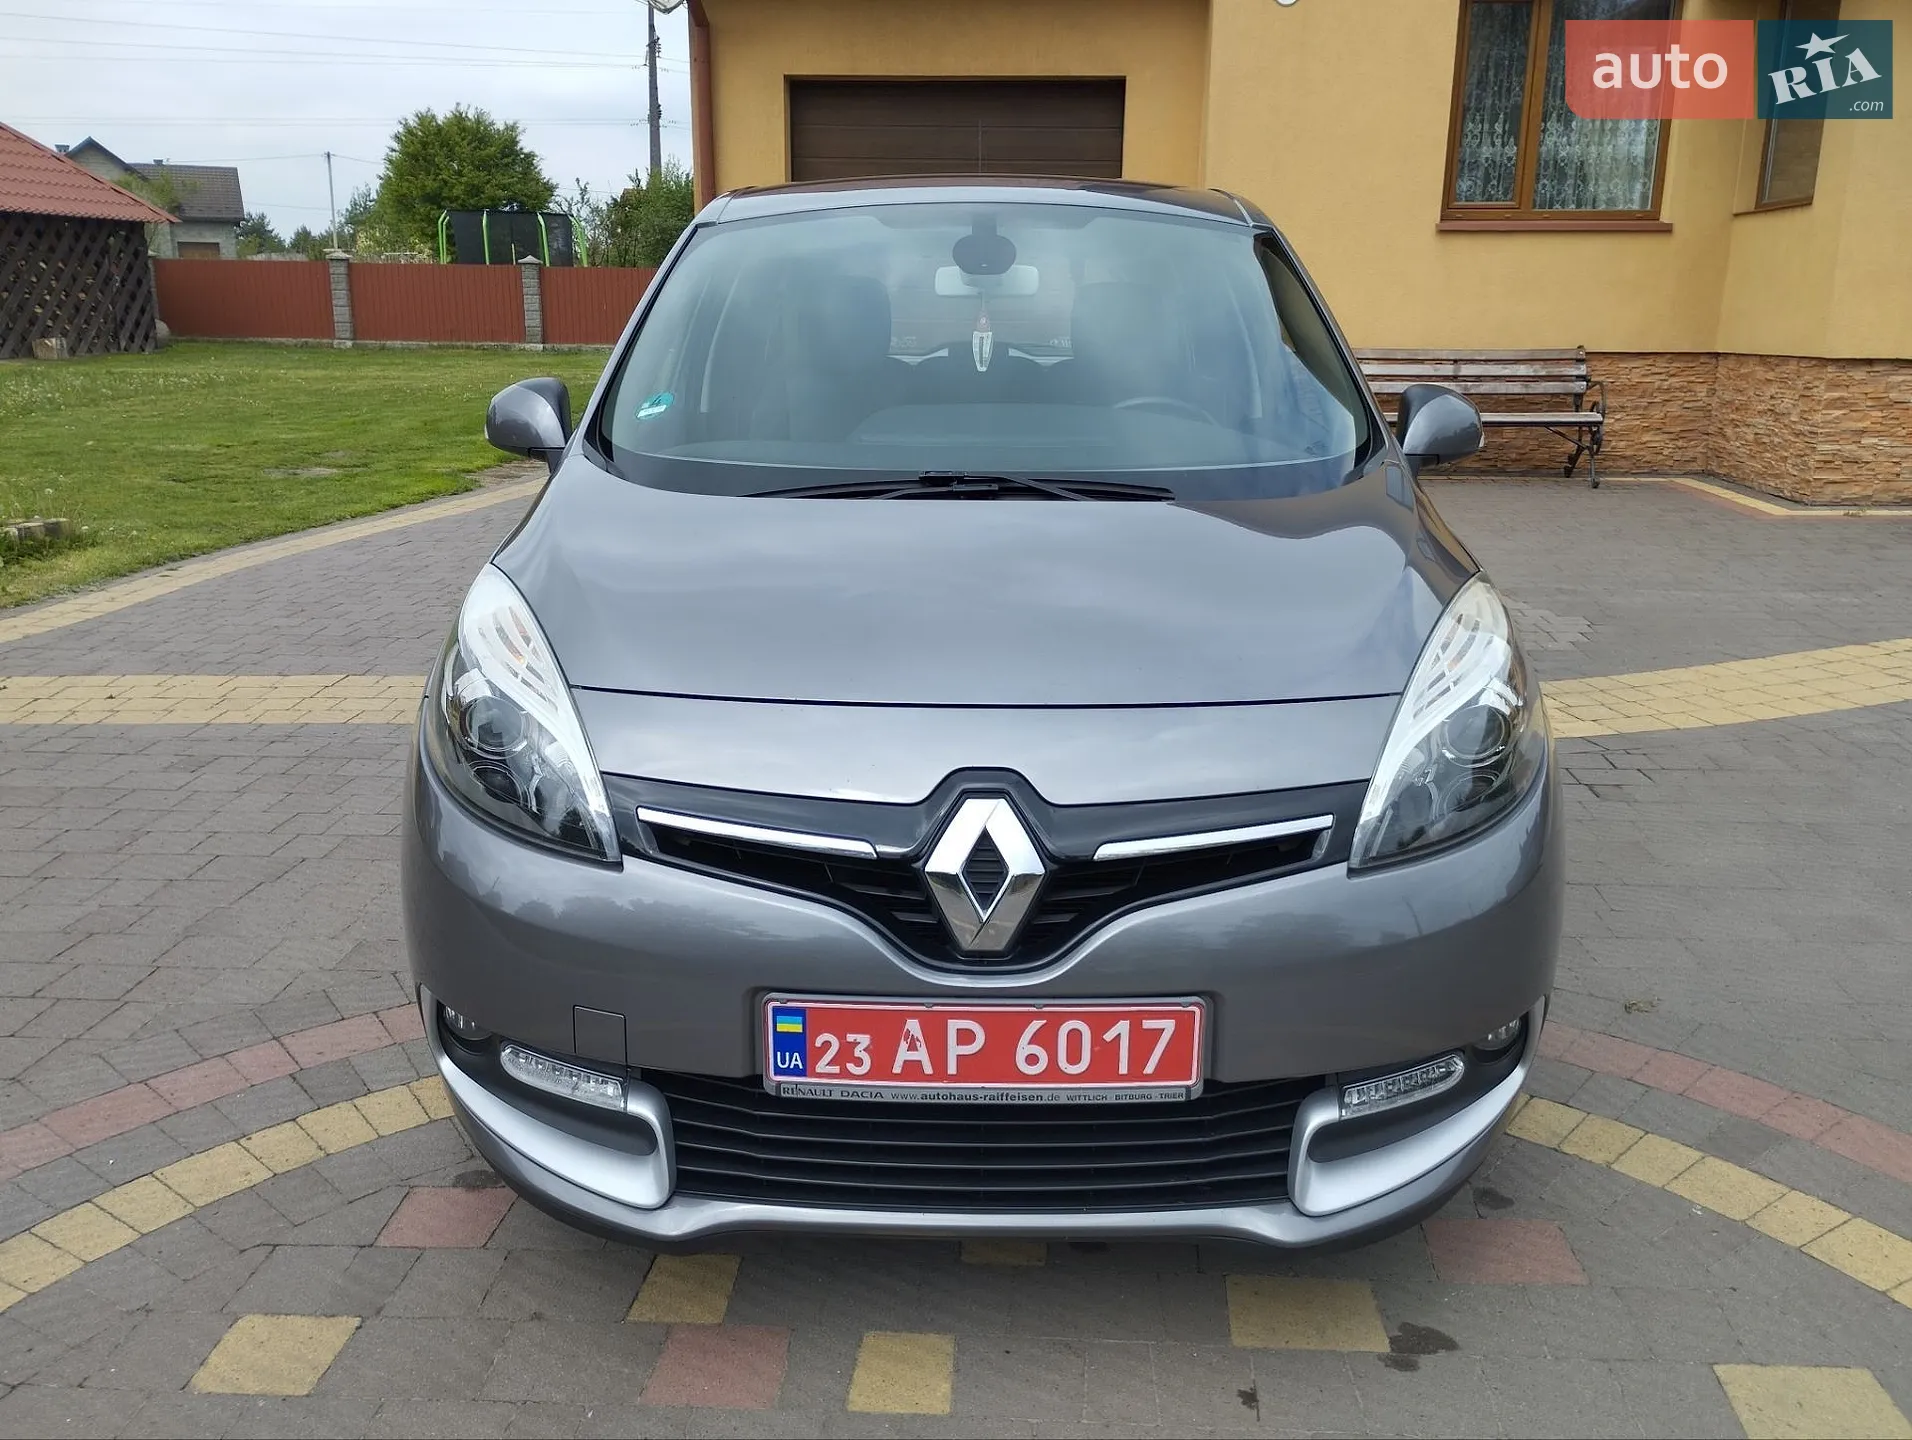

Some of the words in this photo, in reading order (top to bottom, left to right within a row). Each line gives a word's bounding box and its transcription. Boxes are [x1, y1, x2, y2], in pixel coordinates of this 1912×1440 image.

[814, 1033, 872, 1076] 23
[891, 1019, 986, 1076] AP
[1015, 1019, 1177, 1076] 6017
[776, 1052, 803, 1070] UA
[840, 1090, 885, 1100] DACIA
[890, 1090, 1061, 1102] www.autohaus-raiffeisen.de
